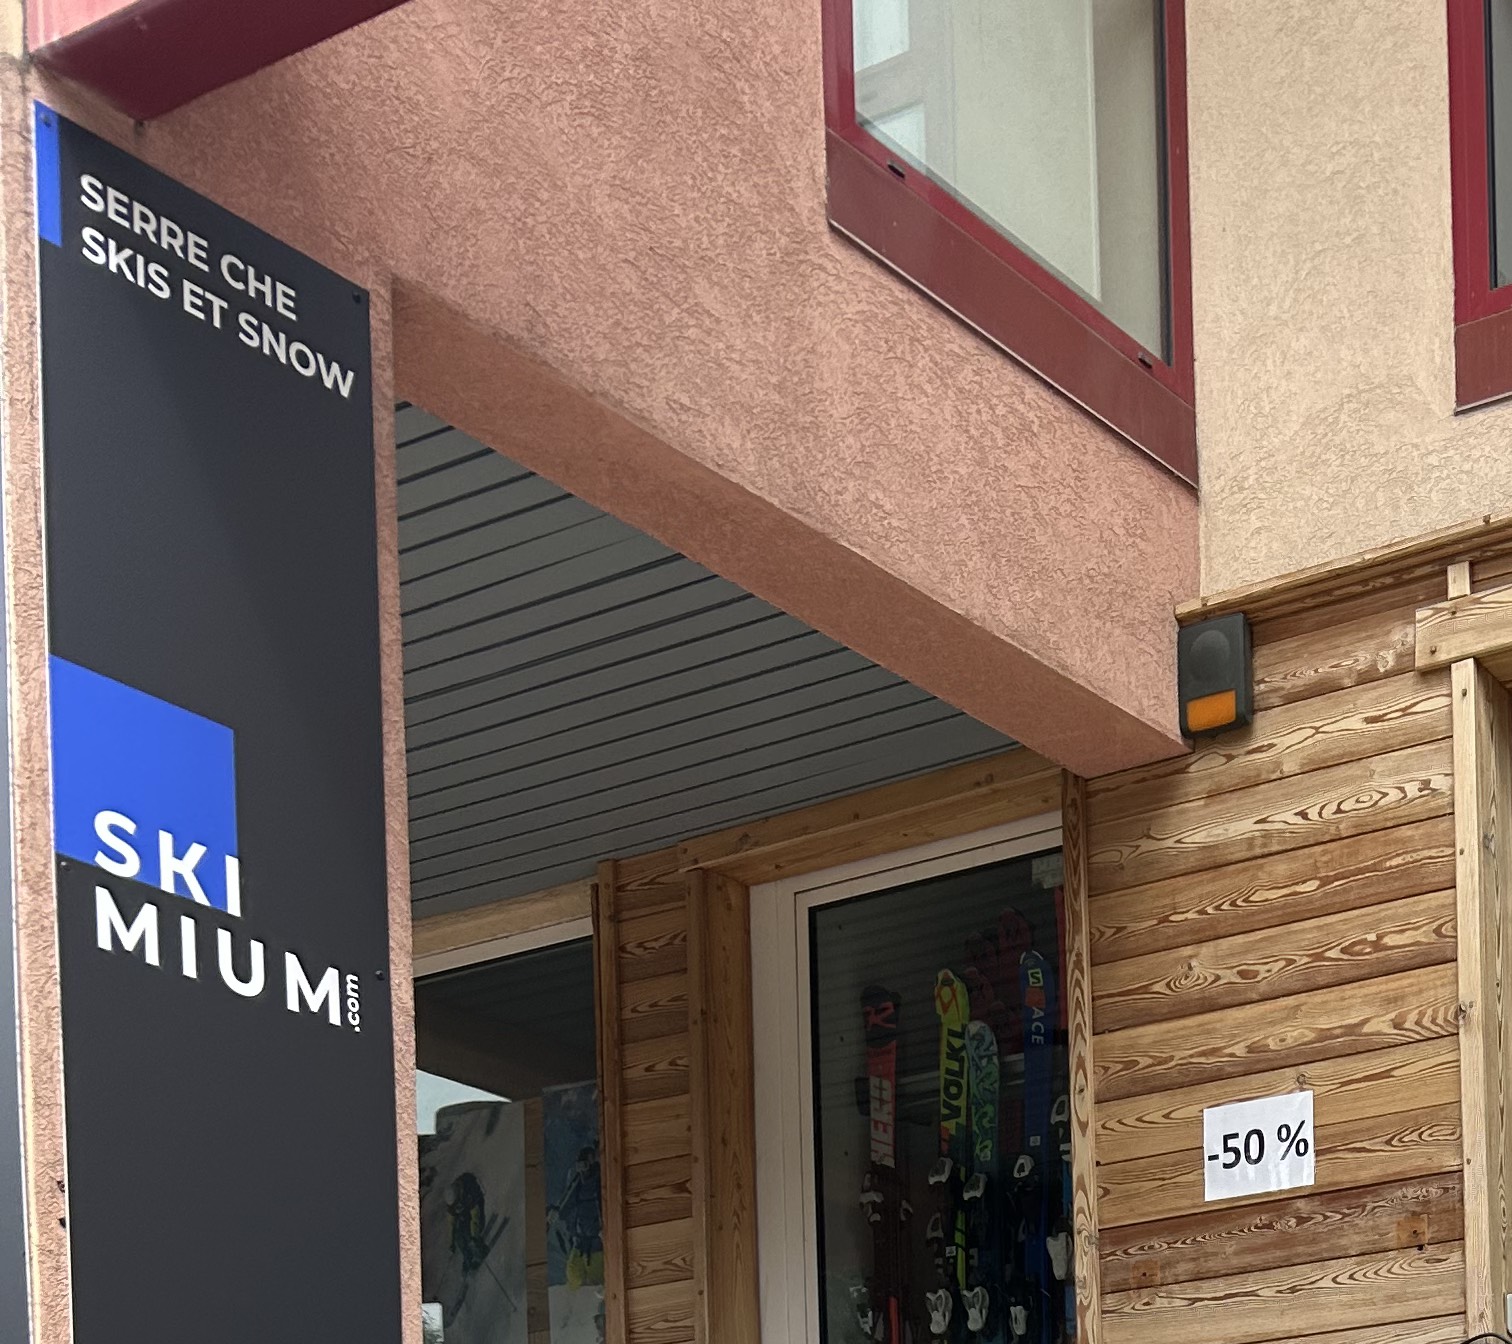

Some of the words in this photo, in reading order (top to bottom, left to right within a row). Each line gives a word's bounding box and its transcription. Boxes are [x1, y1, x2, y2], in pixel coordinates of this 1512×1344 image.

[80, 174, 209, 272] SERRE
[220, 254, 297, 321] CHE
[81, 226, 170, 298] SKIS
[183, 278, 228, 329] ET
[238, 312, 355, 399] SNOW
[93, 810, 241, 918] SKI
[95, 885, 341, 1027] MIUM
[346, 974, 360, 1033] .com
[1208, 1129, 1265, 1169] -50
[1277, 1120, 1309, 1160] %
